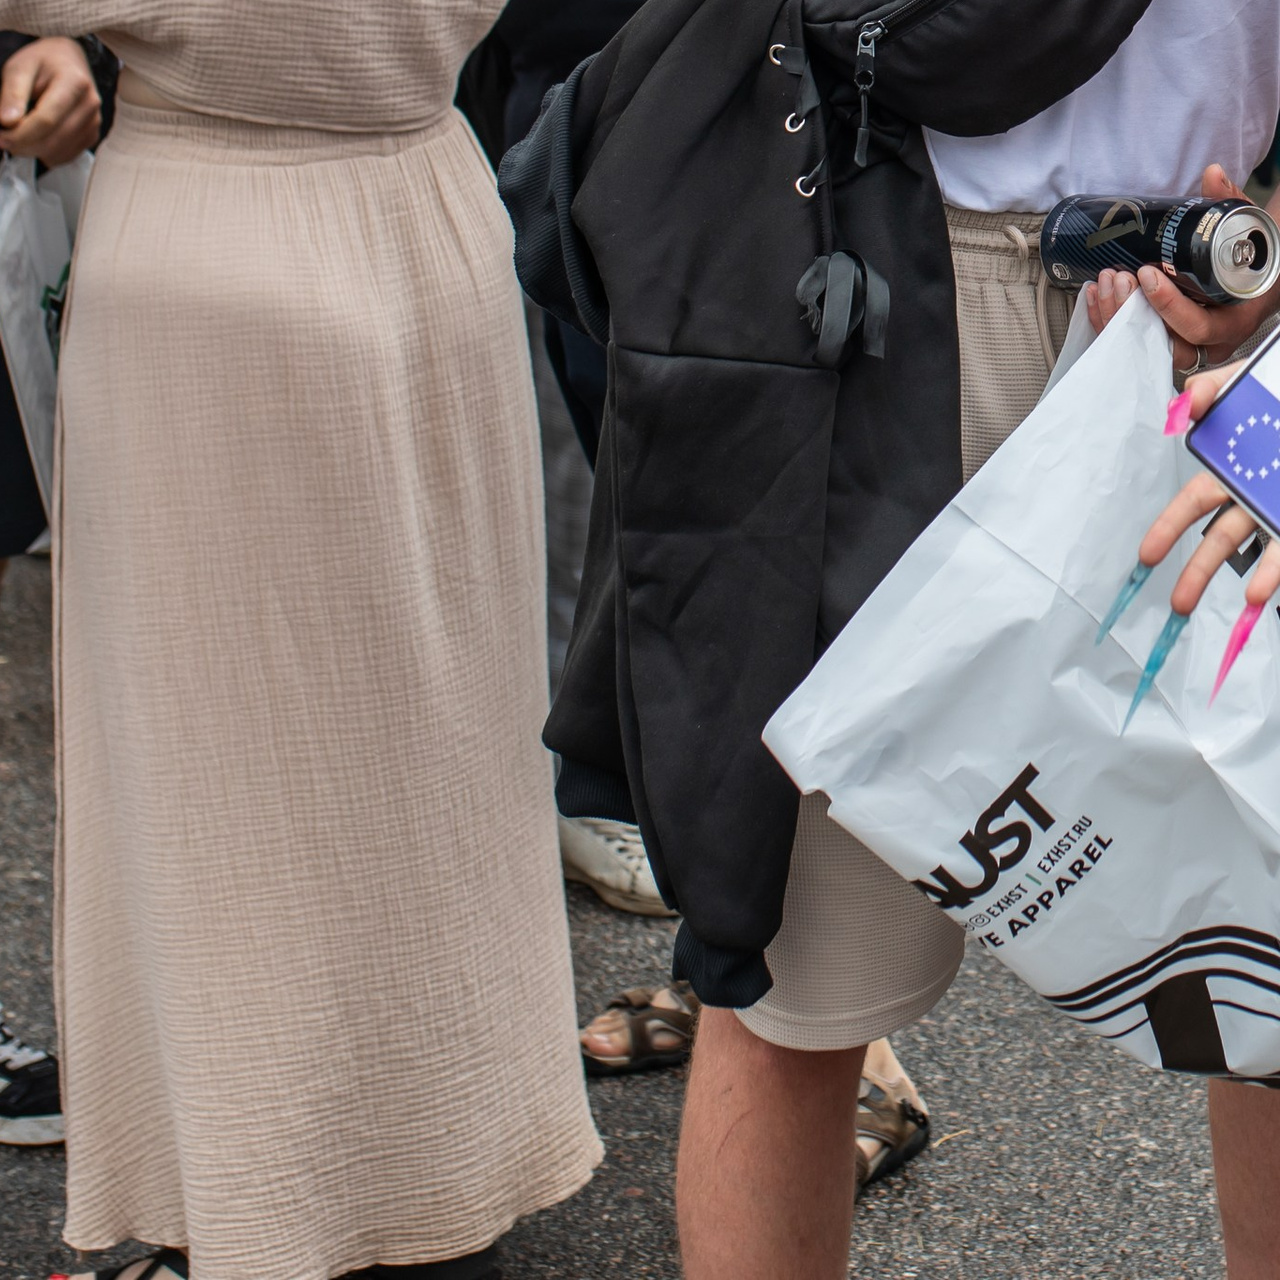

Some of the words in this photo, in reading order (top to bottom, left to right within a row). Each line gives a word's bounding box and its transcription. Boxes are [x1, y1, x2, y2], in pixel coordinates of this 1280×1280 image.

[985, 882, 1029, 920] EXHST
[1036, 814, 1094, 875] EXHST.RU
[1006, 833, 1114, 938] APPAREL
